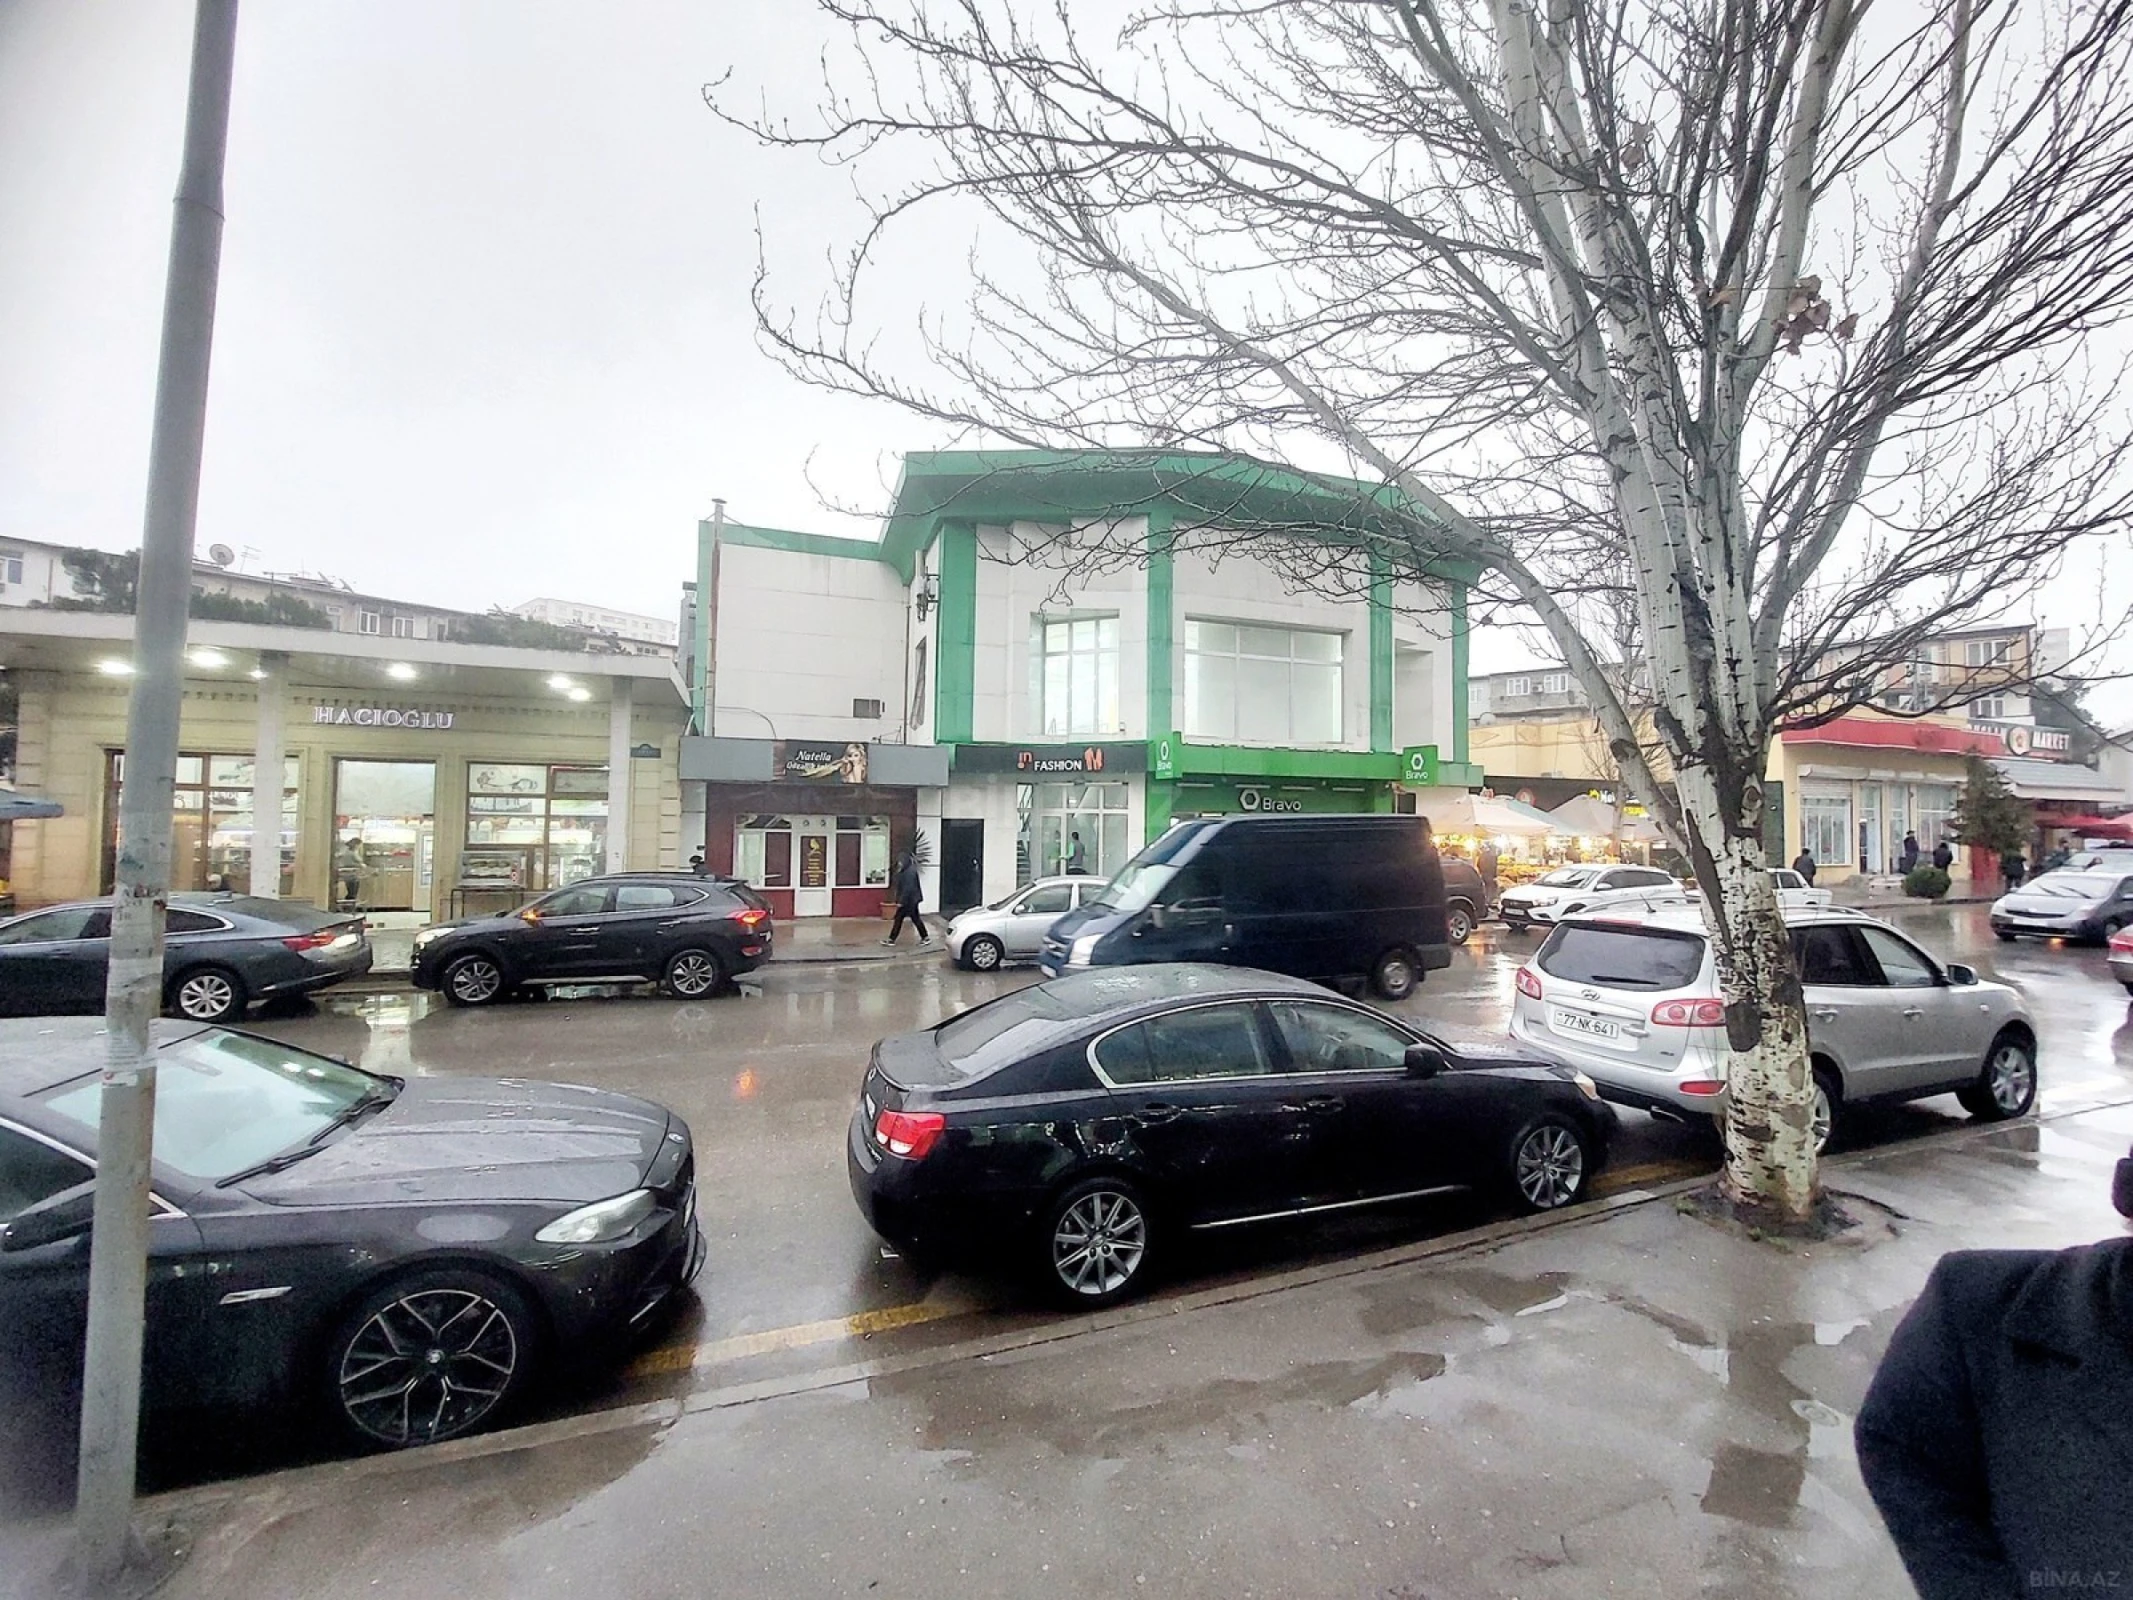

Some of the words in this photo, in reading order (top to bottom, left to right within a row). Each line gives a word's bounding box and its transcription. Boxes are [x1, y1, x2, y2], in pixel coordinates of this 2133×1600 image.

[2032, 731, 2070, 750] MARKET
[795, 750, 832, 761] Natella
[1034, 760, 1083, 771] FASHION
[1405, 770, 1429, 780] Bravo
[1263, 797, 1302, 811] Bravo
